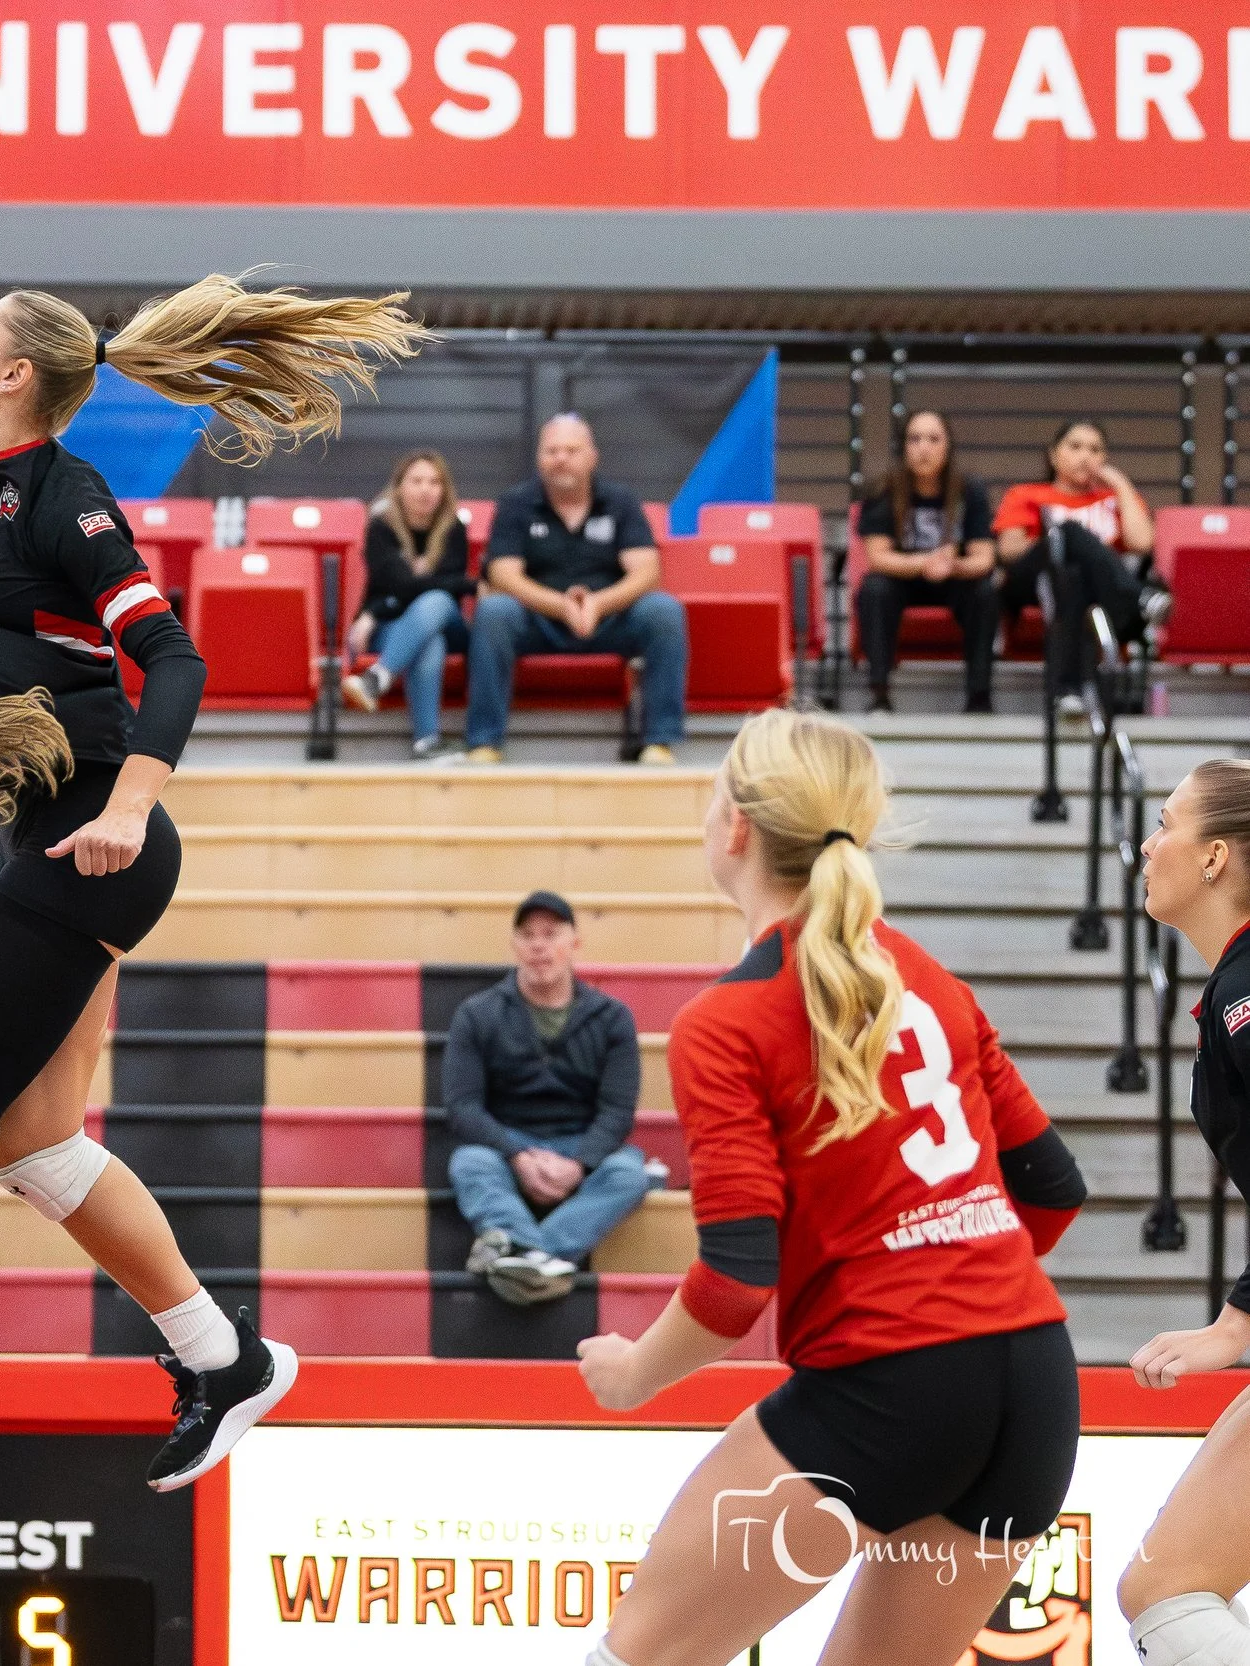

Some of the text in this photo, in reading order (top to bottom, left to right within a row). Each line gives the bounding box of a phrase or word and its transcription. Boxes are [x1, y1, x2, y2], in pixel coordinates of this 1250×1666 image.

[847, 26, 1250, 140] WAR
[887, 990, 981, 1187] 3
[897, 1202, 937, 1227] EAST
[314, 1517, 398, 1539] EAST
[17, 1596, 72, 1666] 5
